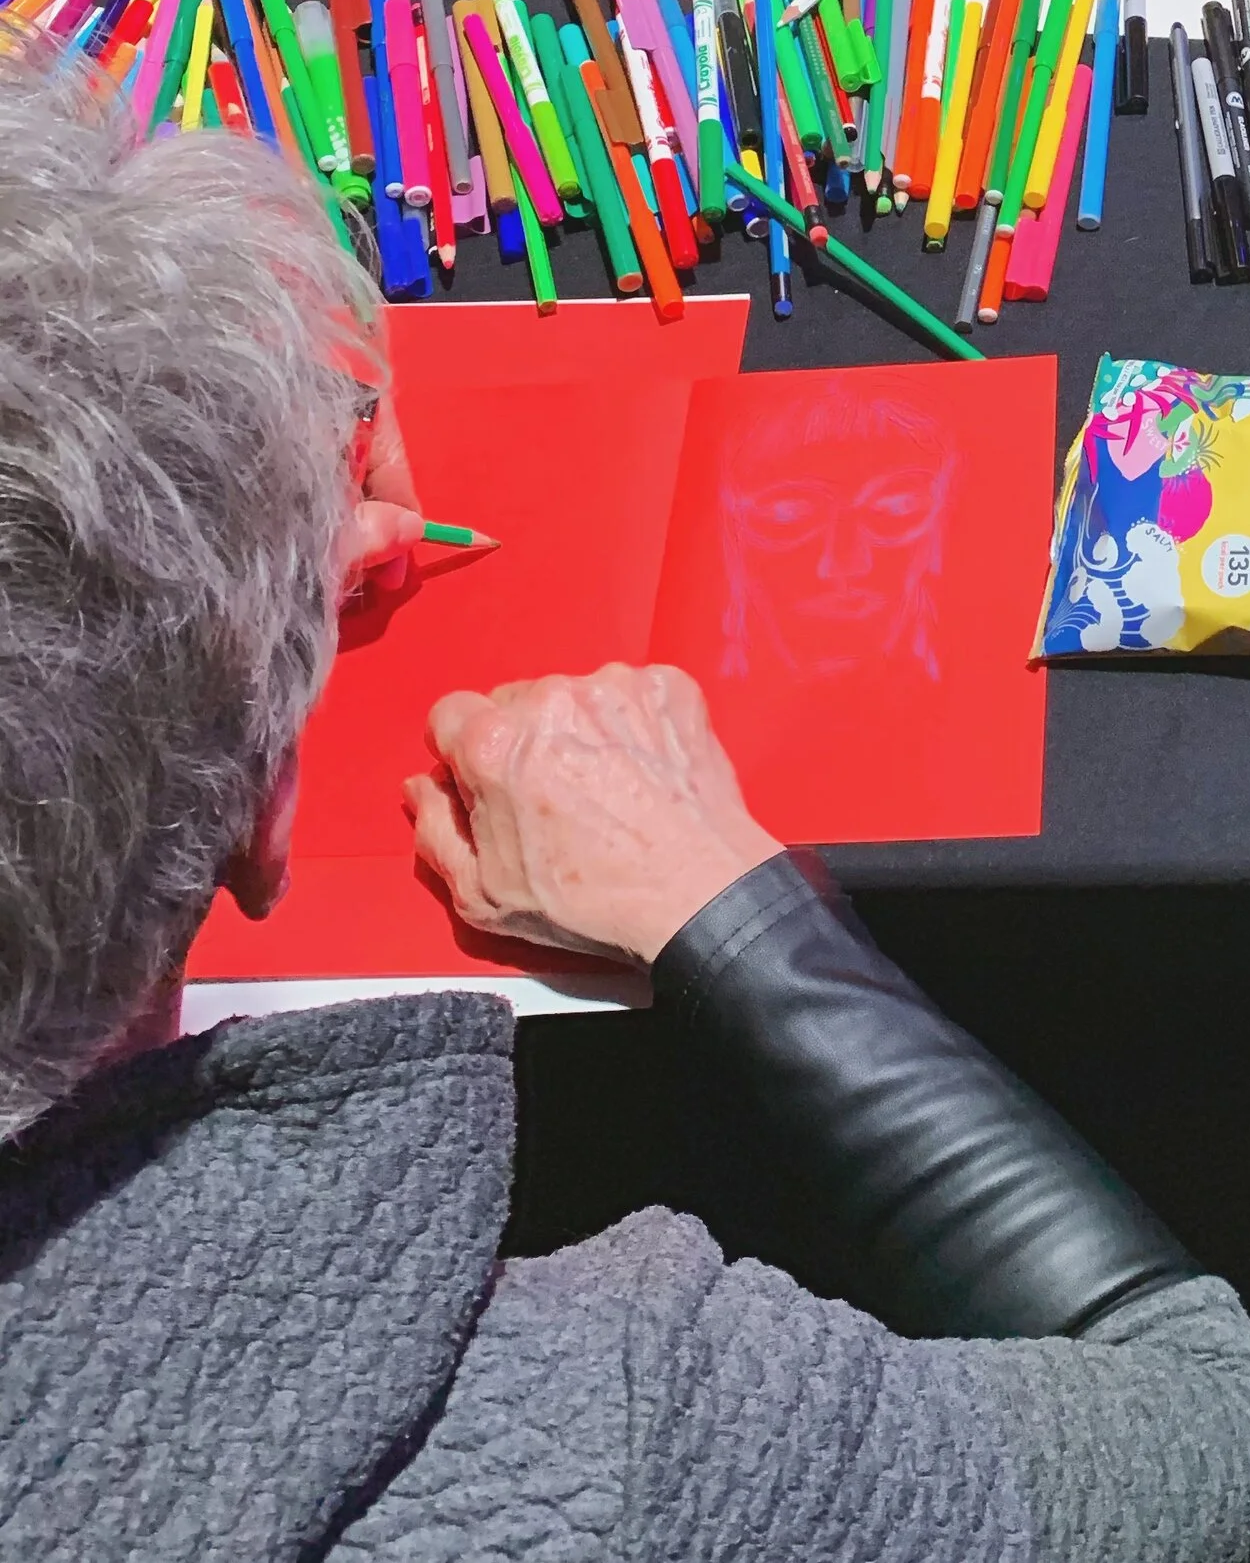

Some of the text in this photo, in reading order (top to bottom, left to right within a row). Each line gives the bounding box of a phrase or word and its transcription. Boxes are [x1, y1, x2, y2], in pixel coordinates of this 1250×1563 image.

[698, 44, 713, 91] Crayola
[1145, 528, 1174, 552] SALTY
[1228, 545, 1250, 586] 135
